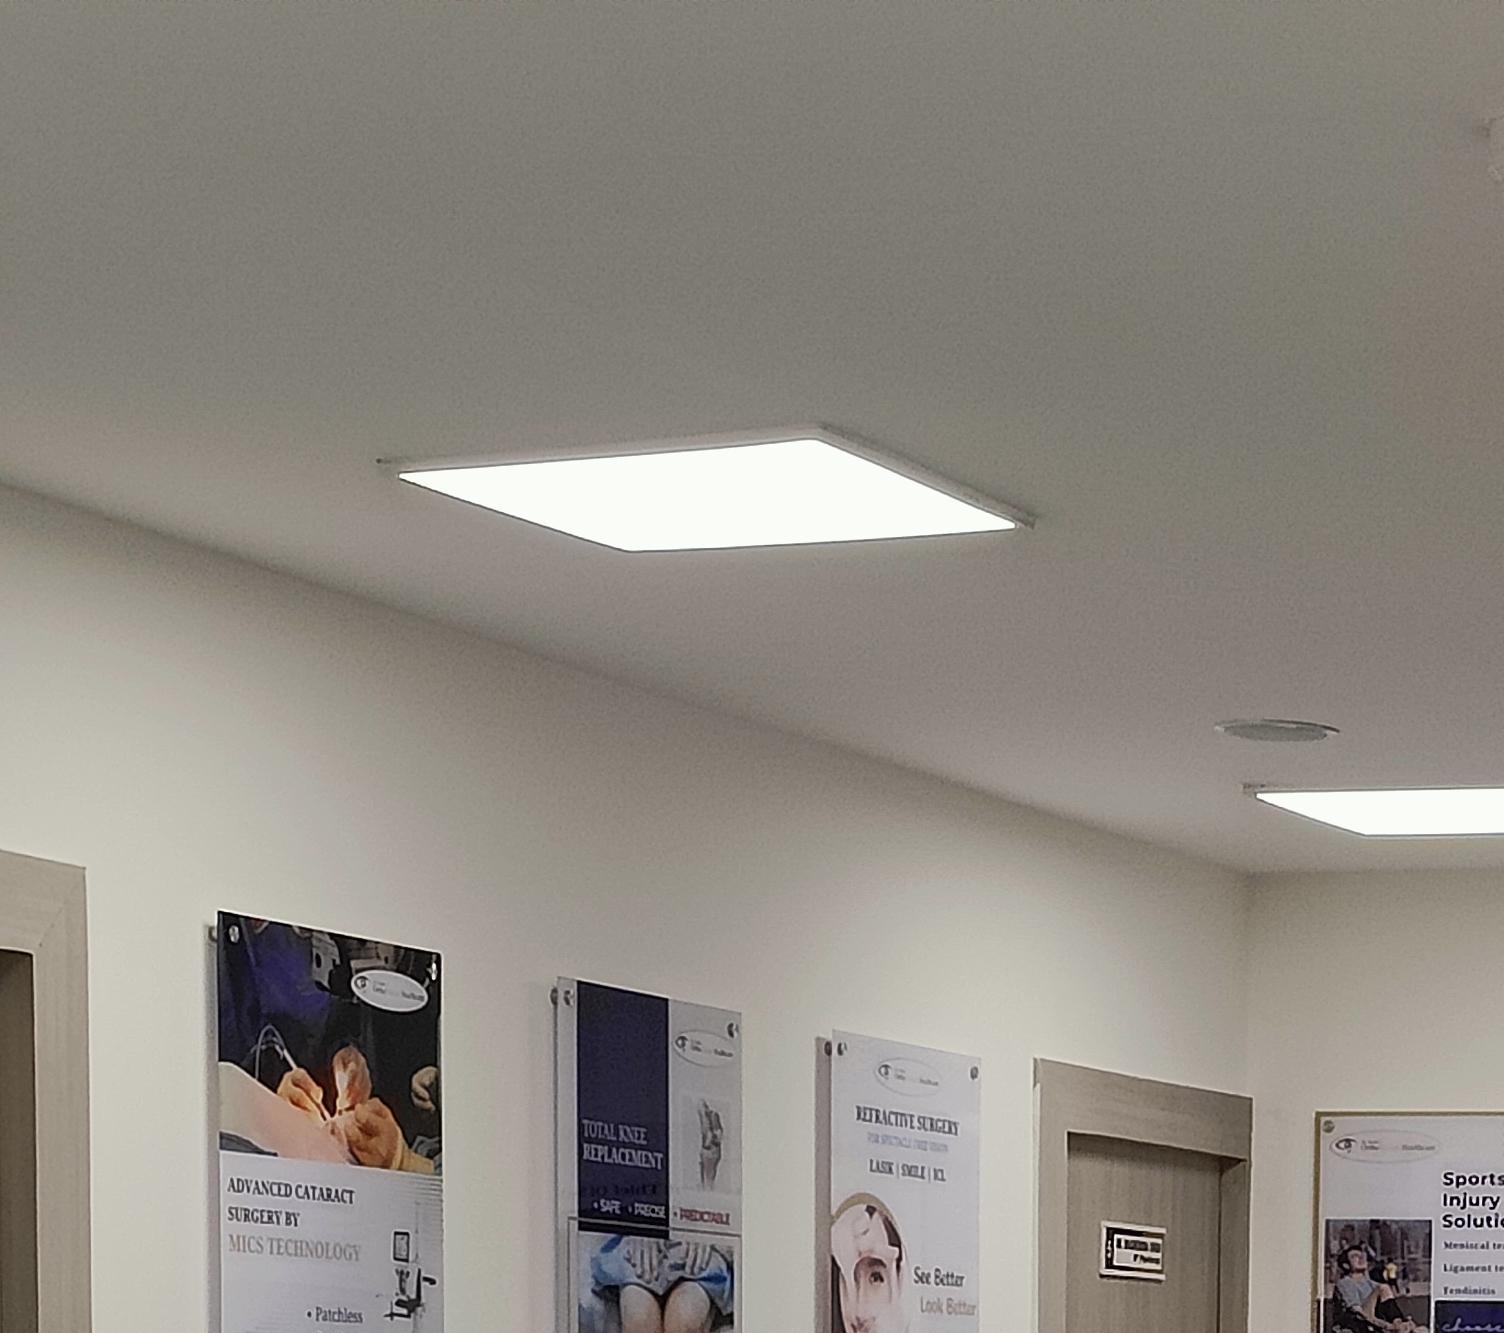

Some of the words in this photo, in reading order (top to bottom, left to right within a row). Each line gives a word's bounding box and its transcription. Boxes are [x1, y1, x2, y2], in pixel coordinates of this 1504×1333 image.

[856, 1105, 915, 1129] REFRACTIVE
[917, 1115, 959, 1136] SURGERY
[581, 1119, 617, 1140] TOTAL
[619, 1124, 647, 1145] KNEE
[583, 1143, 663, 1170] REPLACEMENT
[869, 1159, 894, 1175] LASIK
[228, 1177, 292, 1198] ADVANCED
[295, 1184, 356, 1204] CATARACT
[600, 1199, 621, 1215] SAFE
[634, 1203, 666, 1218] PRECISE
[1443, 1192, 1500, 1210] Injury
[227, 1206, 282, 1225] SURGERY
[285, 1211, 300, 1227] BY
[229, 1234, 264, 1254] MICS
[267, 1237, 361, 1262] TECHNOLOGY
[1443, 1241, 1489, 1250] Meniscal
[914, 1266, 931, 1285] See
[934, 1267, 965, 1287] Better
[1443, 1264, 1491, 1274] Ligament
[316, 1306, 363, 1323] Patchless
[921, 1296, 943, 1313] Look
[946, 1298, 976, 1316] Better
